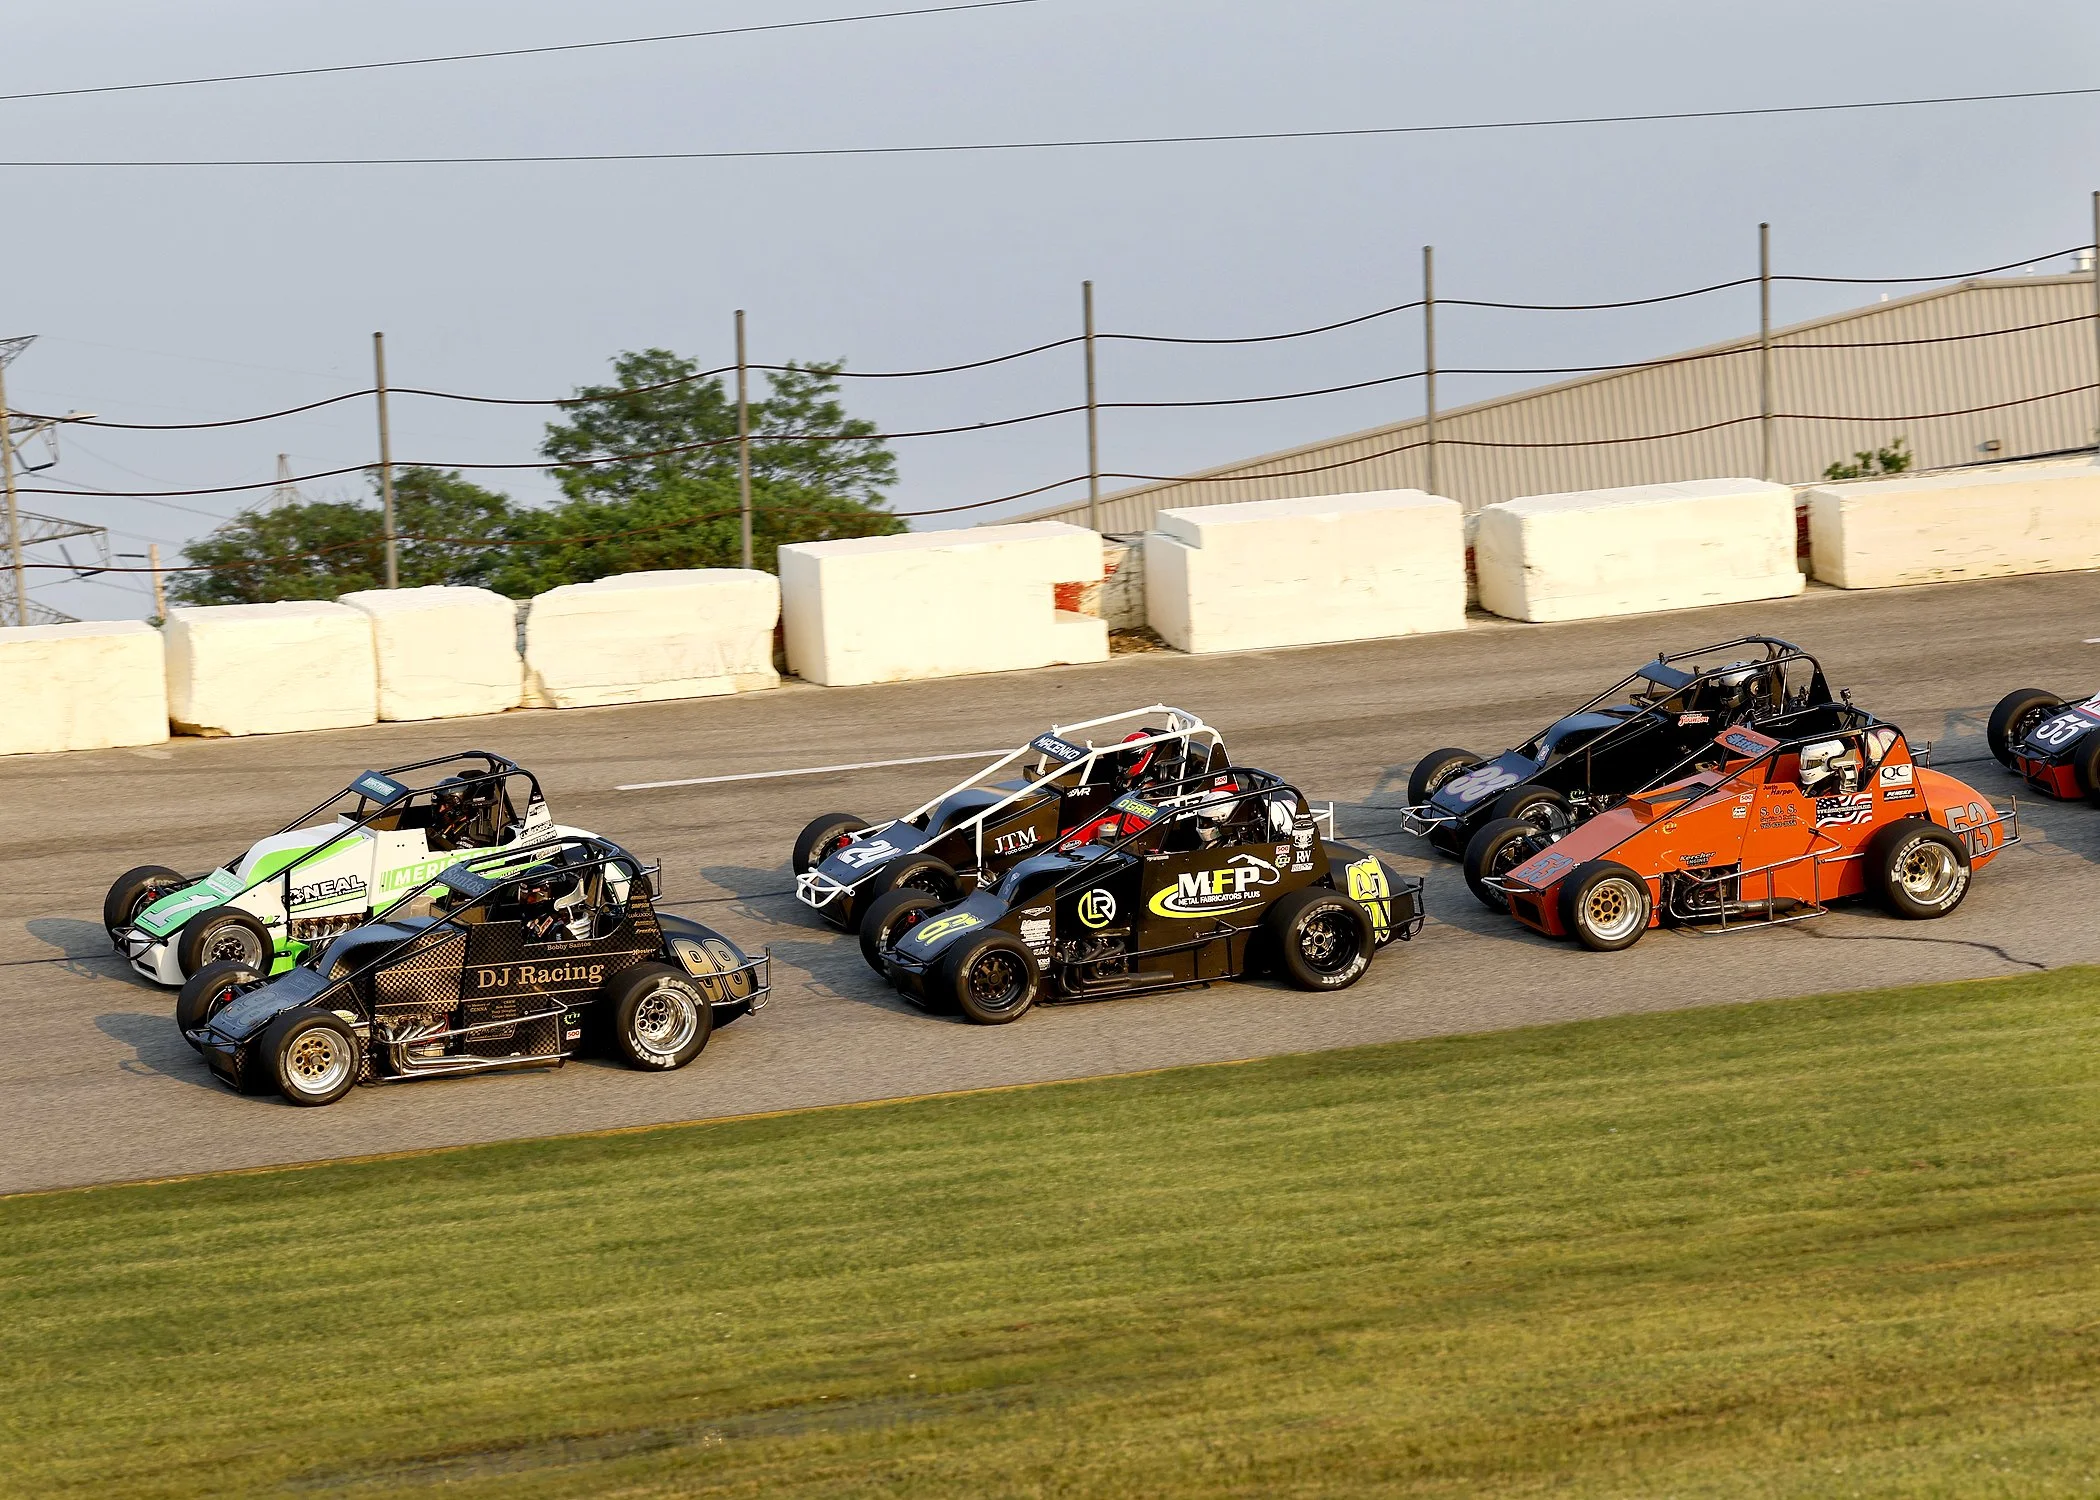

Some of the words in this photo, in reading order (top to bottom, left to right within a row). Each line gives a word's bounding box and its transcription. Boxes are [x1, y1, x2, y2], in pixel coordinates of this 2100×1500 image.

[2036, 714, 2095, 745] 55
[1035, 737, 1080, 760] MACENKO
[1215, 776, 1227, 784] 500
[1881, 765, 1909, 780] QC
[1117, 798, 1158, 817] O'GARA
[1944, 802, 1994, 857] 53
[837, 840, 901, 868] 24
[1516, 852, 1574, 883] 53
[1679, 851, 1716, 861] Kercher
[442, 867, 485, 894] Santos
[1178, 866, 1260, 898] MFP
[1178, 897, 1200, 905] METAL
[1200, 893, 1242, 904] FABRICATORS
[1243, 891, 1261, 899] PLUS
[1345, 855, 1391, 943] 67
[915, 912, 984, 946] 67
[547, 943, 568, 951] Bobby
[569, 941, 591, 949] Santos
[477, 968, 511, 988] DJ
[518, 962, 605, 984] Racing
[671, 939, 750, 1002] 98
